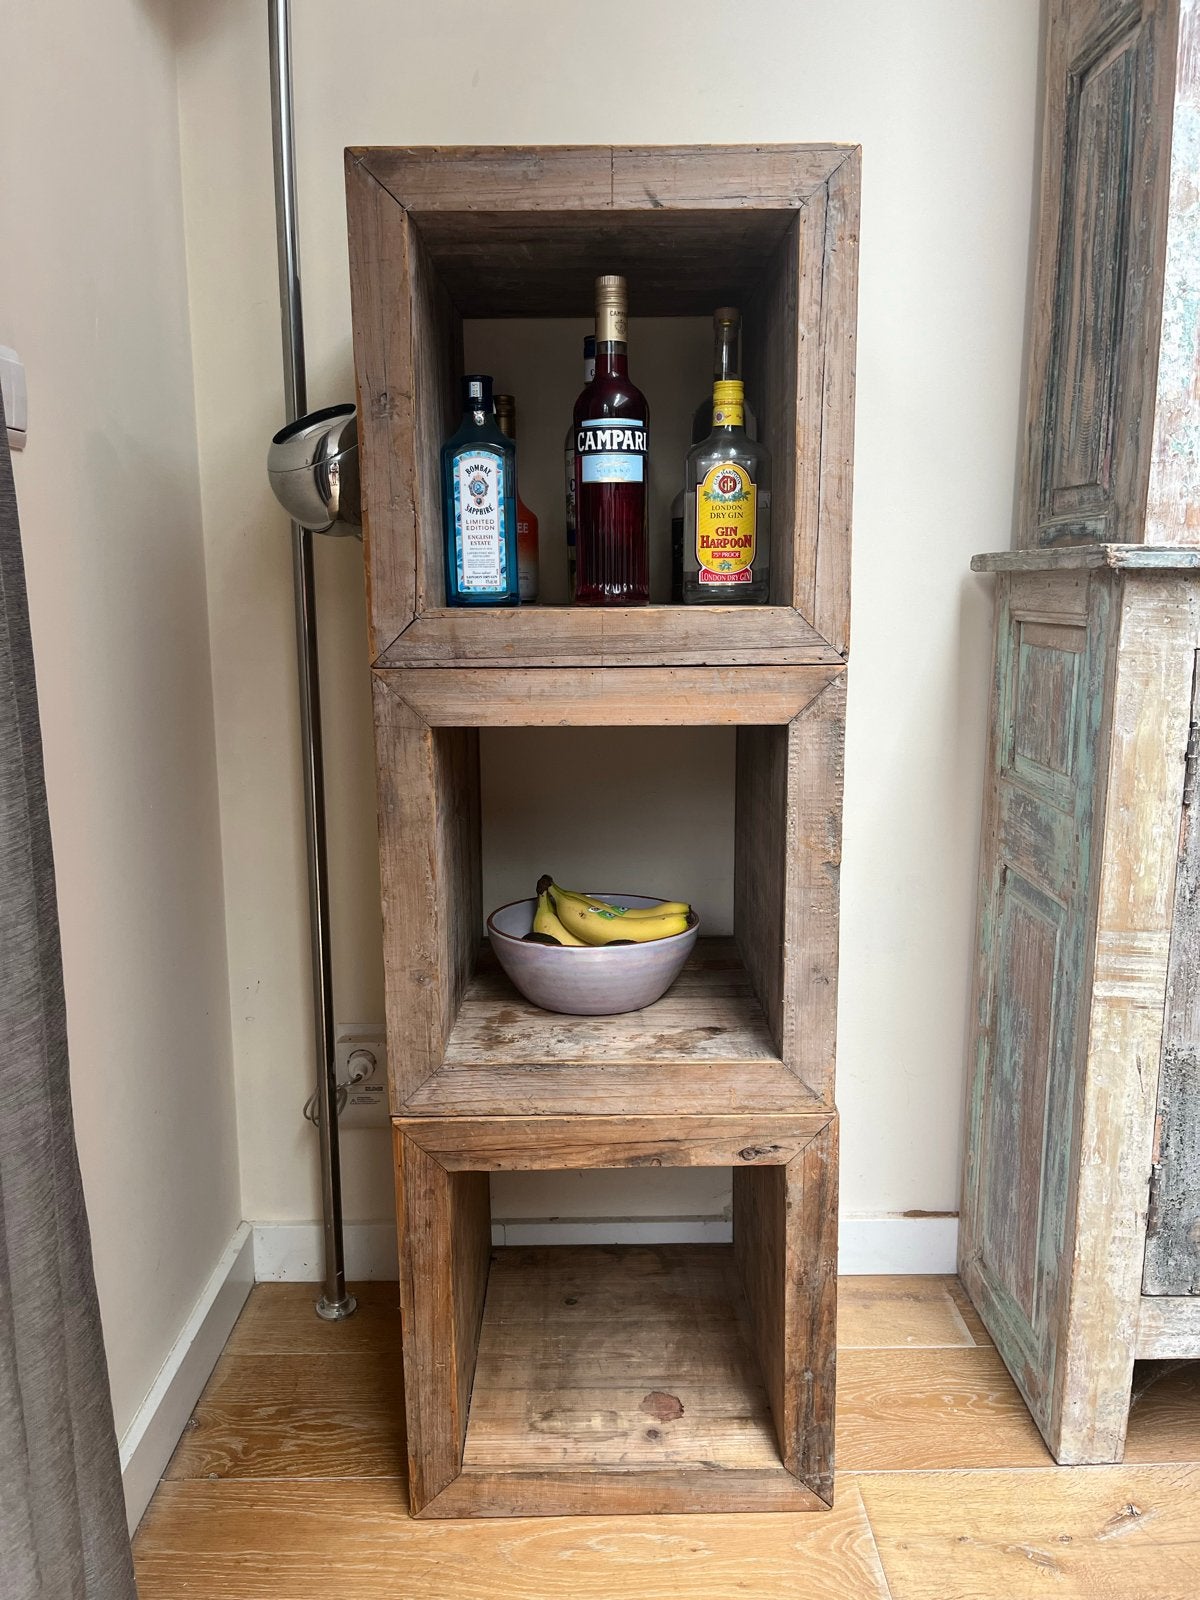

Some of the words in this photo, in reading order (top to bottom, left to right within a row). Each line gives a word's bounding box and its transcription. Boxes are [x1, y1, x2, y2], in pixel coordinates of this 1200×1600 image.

[577, 429, 647, 452] CAMPARI
[465, 464, 492, 477] BOMBAY
[720, 478, 734, 491] GH
[464, 503, 494, 515] SAPPHIRE
[715, 526, 738, 536] GIN
[700, 535, 752, 548] HARPOON
[701, 571, 725, 582] LONDON
[727, 574, 739, 582] DRY
[739, 571, 750, 581] GIN
